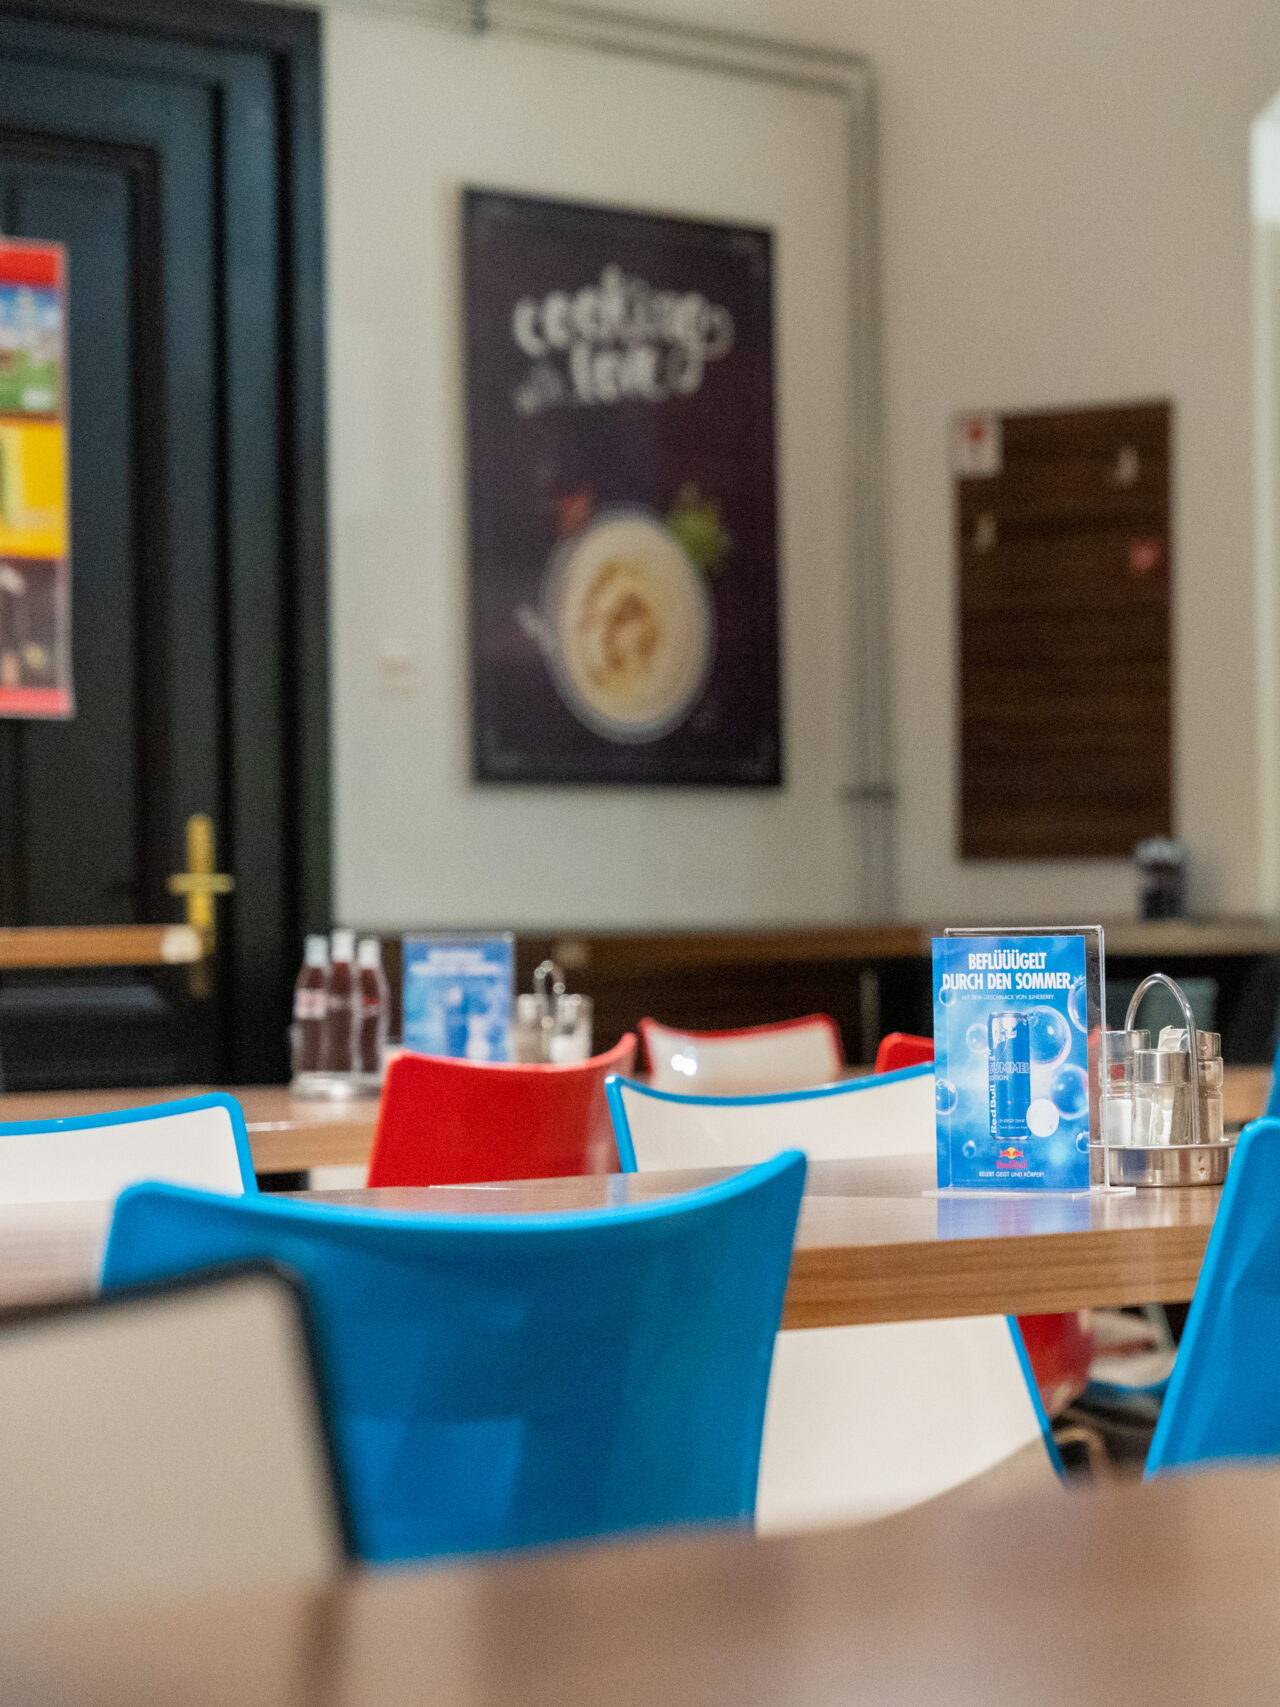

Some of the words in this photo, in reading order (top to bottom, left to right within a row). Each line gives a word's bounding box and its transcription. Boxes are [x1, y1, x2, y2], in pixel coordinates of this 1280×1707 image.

[968, 949, 1047, 970] BEFLÜÜÜGELT
[942, 973, 984, 990] DURCH
[987, 973, 1012, 990] DEN
[1015, 973, 1075, 990] SOMMER.
[996, 1160, 1011, 1169] Red
[1012, 1160, 1027, 1169] Bull
